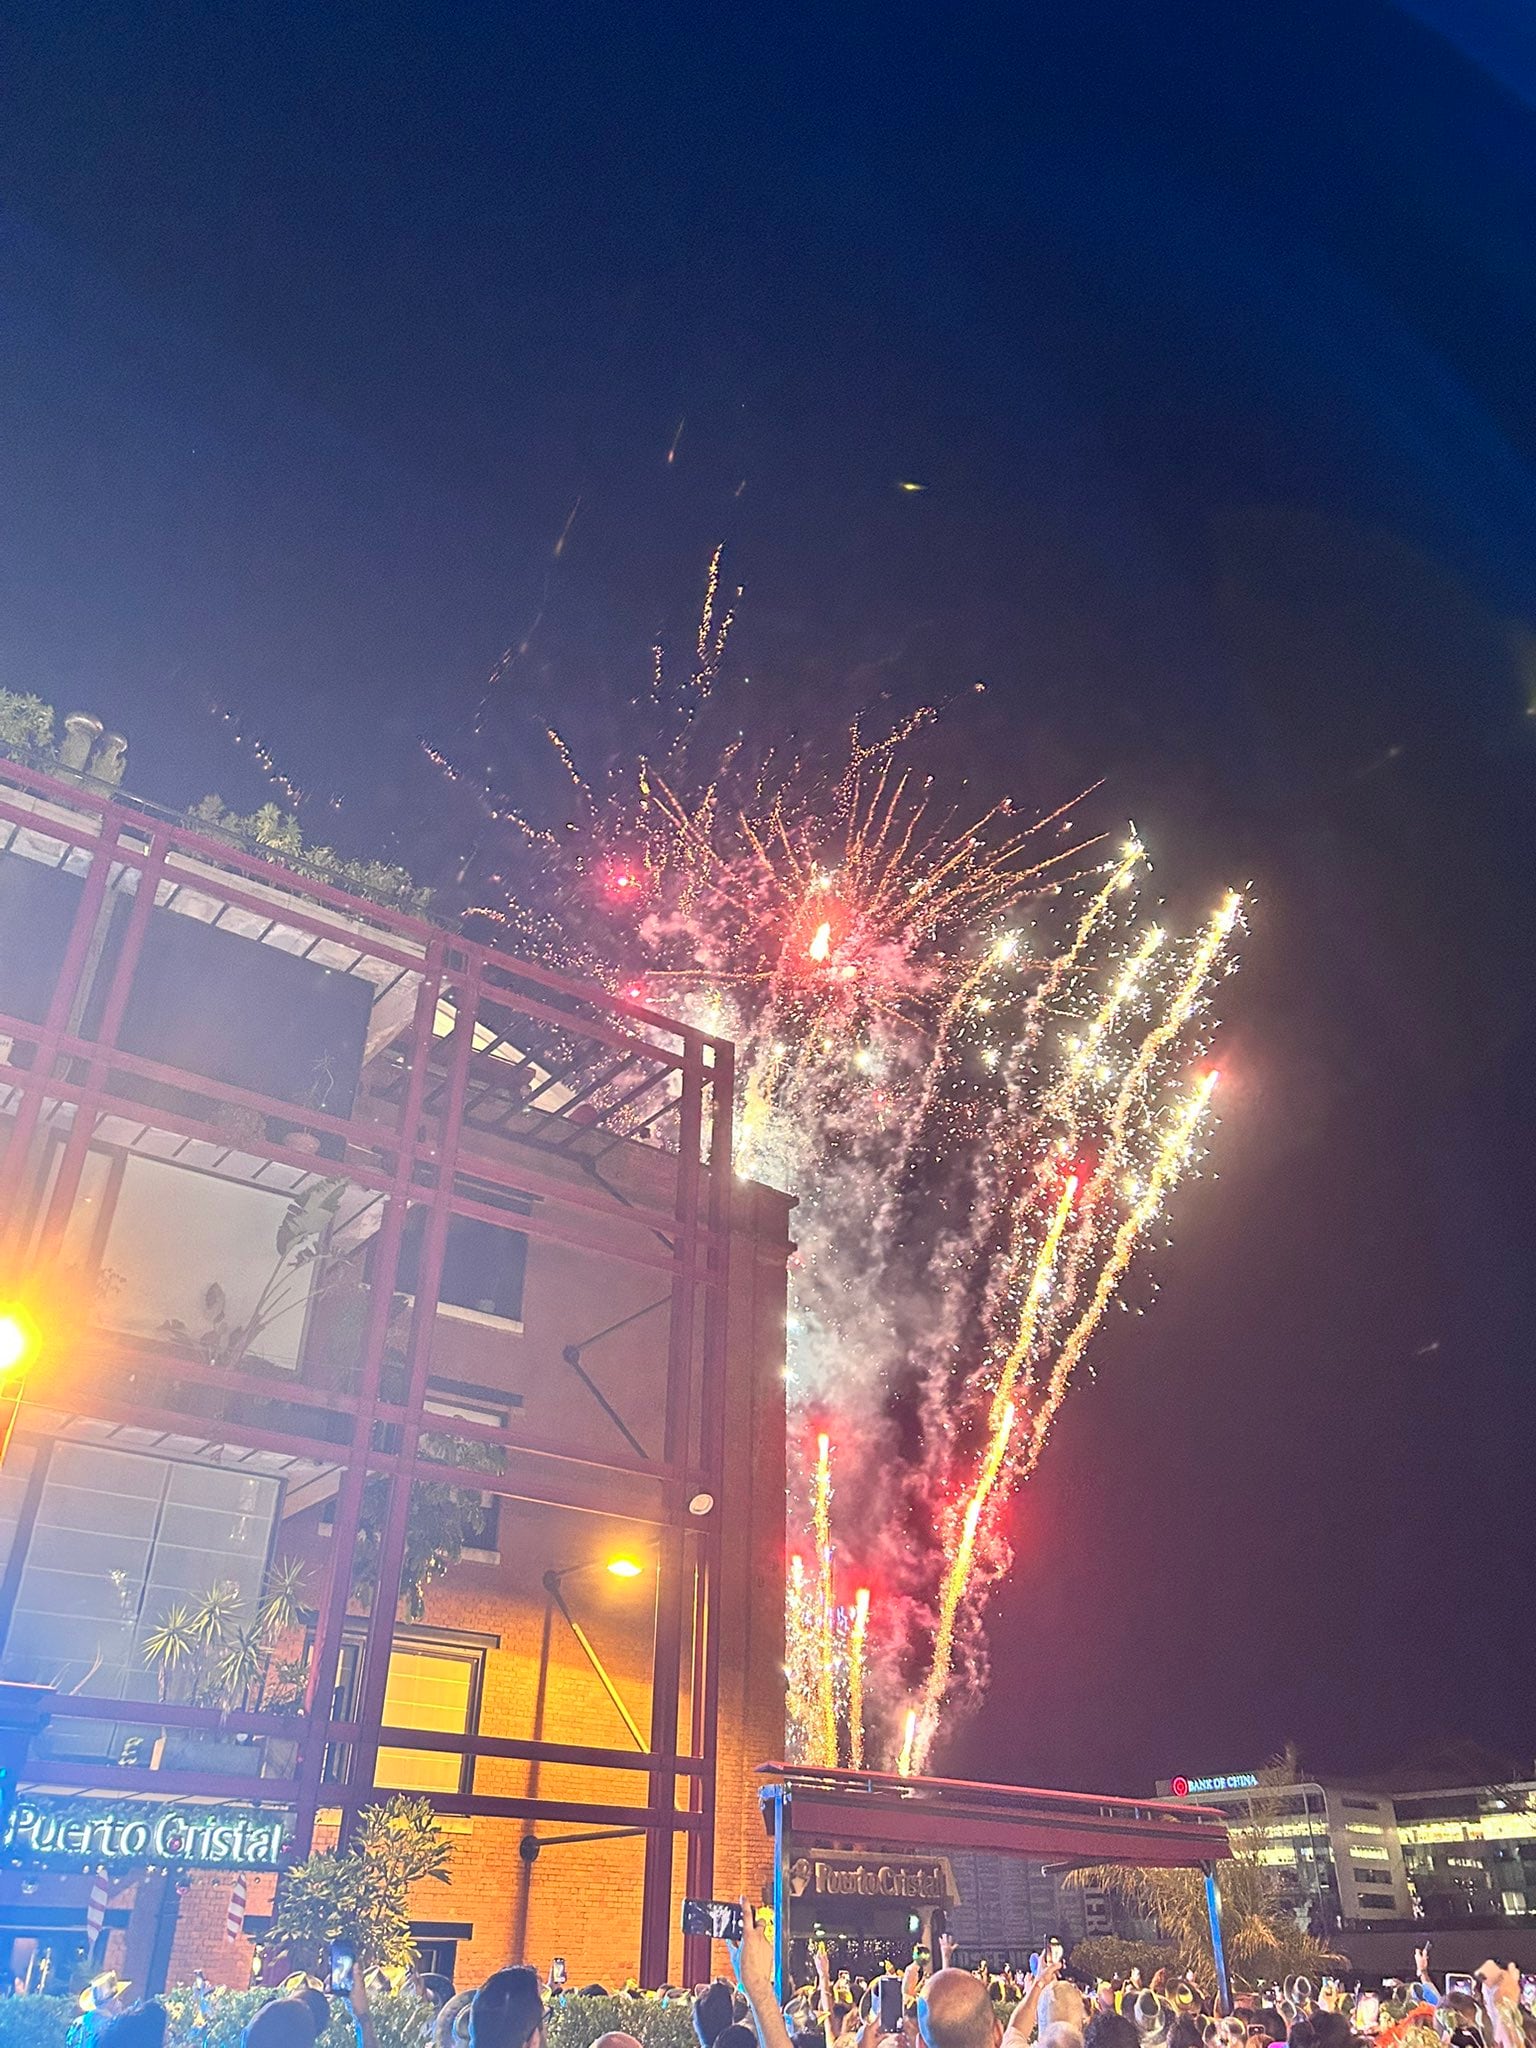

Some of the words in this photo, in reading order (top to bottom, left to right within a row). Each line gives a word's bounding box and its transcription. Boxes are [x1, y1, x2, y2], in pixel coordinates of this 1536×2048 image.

[1188, 1779, 1213, 1793] BANK
[1213, 1777, 1226, 1790] OF
[1226, 1774, 1258, 1787] CHINA
[4, 1803, 147, 1856] Puerto
[154, 1812, 283, 1863] Cristal
